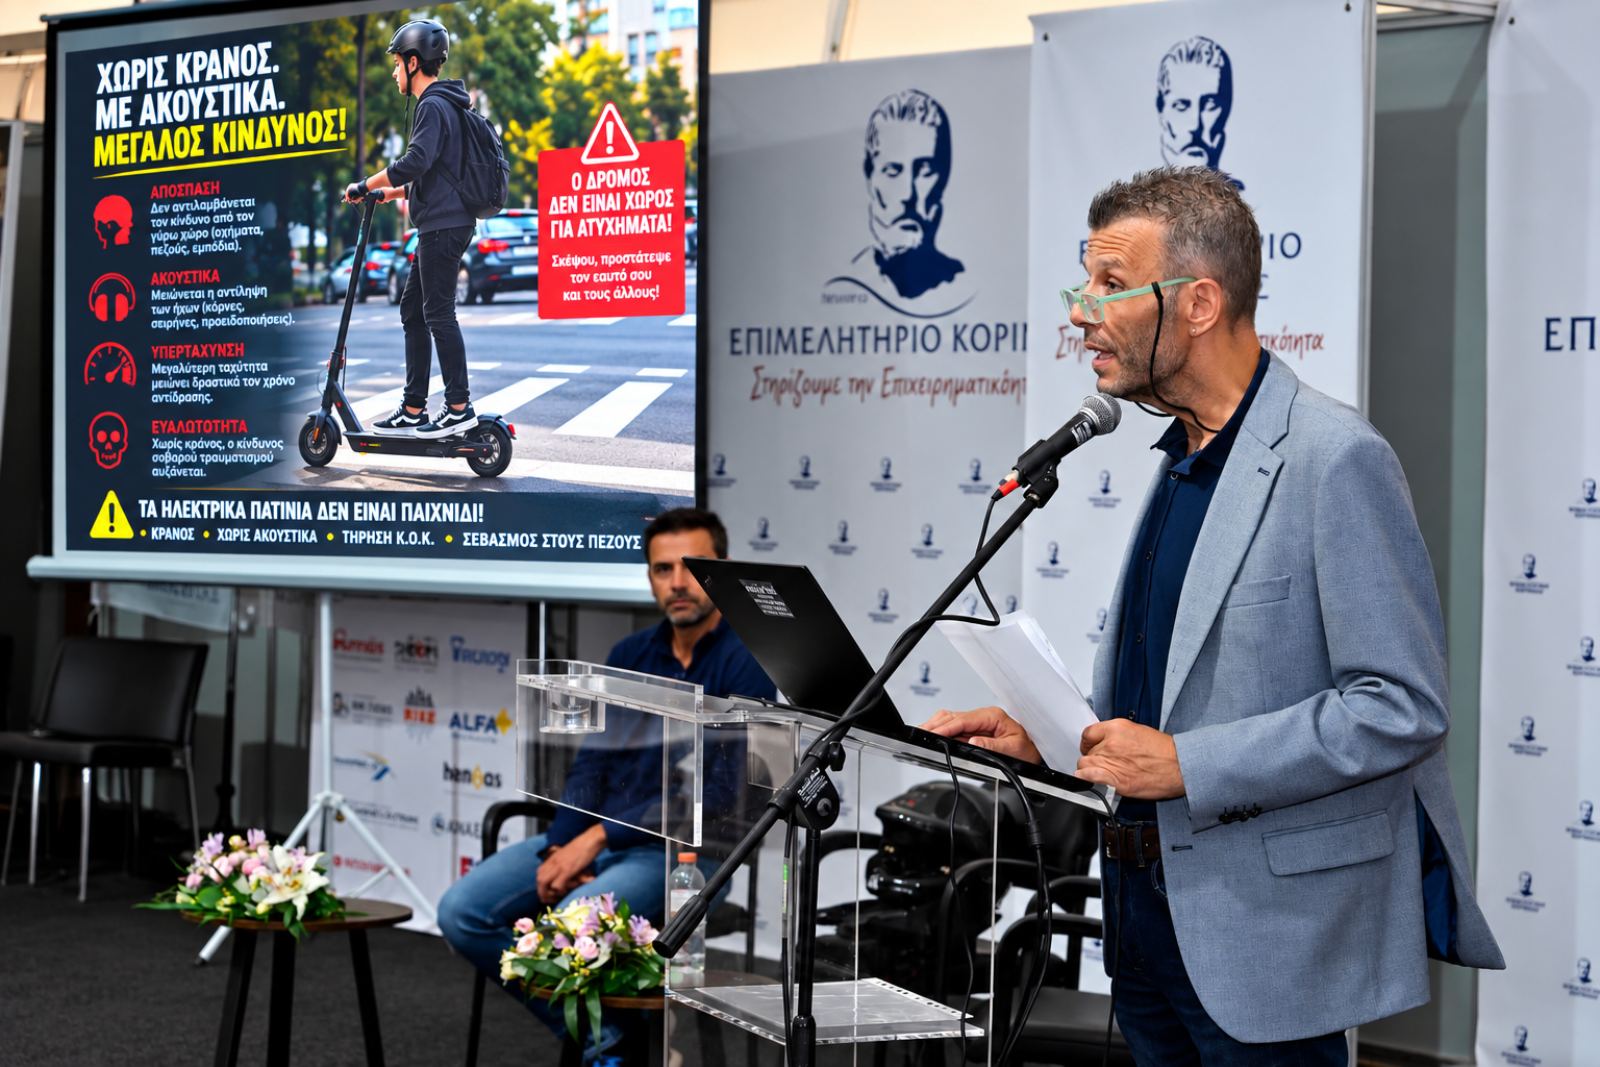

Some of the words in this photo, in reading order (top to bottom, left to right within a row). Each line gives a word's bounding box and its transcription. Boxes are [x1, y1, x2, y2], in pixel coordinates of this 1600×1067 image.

[97, 55, 169, 95] ΧΩΡΙΣ
[176, 41, 280, 85] ΚΡΑΝΟΣ.
[95, 98, 132, 131] ΜΕ
[139, 78, 286, 127] ΑΚΟΥΣΤΙΚΑ.
[94, 125, 205, 167] ΜΕΓΑΛΟΣ
[213, 107, 347, 154] ΚΙΝΔΥΝΟΣ!
[571, 172, 582, 191] Ο
[586, 167, 651, 190] ΔΡΟΜΟΣ
[150, 181, 221, 199] ΑΠΟΣΠΑΣΗ
[150, 202, 170, 214] Δεν
[172, 197, 256, 214] αντιλαμβάνεται
[549, 195, 578, 215] ΔΕΝ
[582, 192, 621, 213] ΕΙΝΑΙ
[625, 188, 674, 211] ΧΩΡΟΣ
[151, 217, 169, 227] τον
[171, 213, 211, 226] κίνδυνο
[213, 211, 234, 224] από
[236, 212, 255, 222] τον
[550, 219, 574, 239] ΓΙΑ
[577, 213, 672, 238] ΑΤΥΧΗΜΑΤΑ!
[151, 228, 178, 243] γύρω
[180, 227, 209, 242] χώρο
[211, 225, 264, 240] (οχήματα,
[151, 242, 190, 257] πεζούς,
[192, 239, 242, 255] εμπόδια).
[551, 253, 598, 270] Σκέψου,
[601, 250, 672, 268] προστάτεψε
[151, 268, 221, 286] ΑΚΟΥΣΤΙΚΑ
[570, 273, 590, 284] τον
[593, 268, 627, 283] εαυτό
[630, 270, 652, 281] σου
[151, 287, 205, 300] Μειώνεται
[208, 289, 214, 300] η
[217, 285, 268, 299] αντίληψη
[563, 290, 581, 301] και
[584, 288, 611, 302] τους
[613, 285, 660, 300] άλλους!
[151, 305, 170, 314] των
[173, 302, 200, 316] ήχων
[202, 301, 245, 315] (κόρνες,
[151, 316, 199, 331] σειρήνες,
[202, 312, 296, 329] προειδοποιήσεις).
[729, 323, 942, 356] ΕΠΙΜΕΛΗΤΗΡΙΟ
[151, 342, 245, 359] ΥΠΕΡΤΑΧΥΝΣΗ
[152, 362, 216, 376] Μεγαλύτερη
[218, 361, 268, 374] ταχύτητα
[152, 378, 190, 391] μειώνει
[192, 375, 241, 390] δραστικά
[243, 376, 261, 387] τον
[263, 374, 296, 389] χρόνο
[750, 365, 841, 408] Στηρίζουμε
[848, 374, 875, 404] την
[152, 391, 214, 405] αντίδρασης.
[151, 419, 248, 434] ΕΥΑΛΩΤΟΤΗΤΑ
[152, 437, 183, 450] Χωρίς
[185, 438, 225, 451] κράνος,
[227, 440, 234, 449] ο
[237, 437, 284, 450] κίνδυνος
[152, 451, 198, 465] σοβαρού
[200, 451, 274, 465] τραυματισμού
[152, 466, 207, 479] αυξάνεται.
[138, 499, 158, 519] ΤΑ
[161, 500, 246, 520] ΗΛΕΚΤΡΙΚΑ
[250, 501, 313, 521] ΠΑΤΙΝΙΑ
[317, 501, 349, 521] ΔΕΝ
[353, 502, 396, 522] ΕΙΝΑΙ
[401, 502, 484, 523] ΠΑΙΧΝΙΔΙ!
[151, 527, 195, 541] ΚΡΑΝΟΣ
[216, 528, 250, 542] ΧΩΡΙΣ
[253, 528, 318, 544] ΑΚΟΥΣΤΙΚΑ
[342, 530, 392, 545] ΤΗΡΗΣΗ
[396, 531, 435, 546] Κ.Ο.Κ.
[463, 532, 538, 548] ΣΕΒΑΣΜΟΣ
[542, 533, 584, 549] ΣΤΟΥΣ
[588, 534, 642, 550] ΠΕΖΟΥΣ
